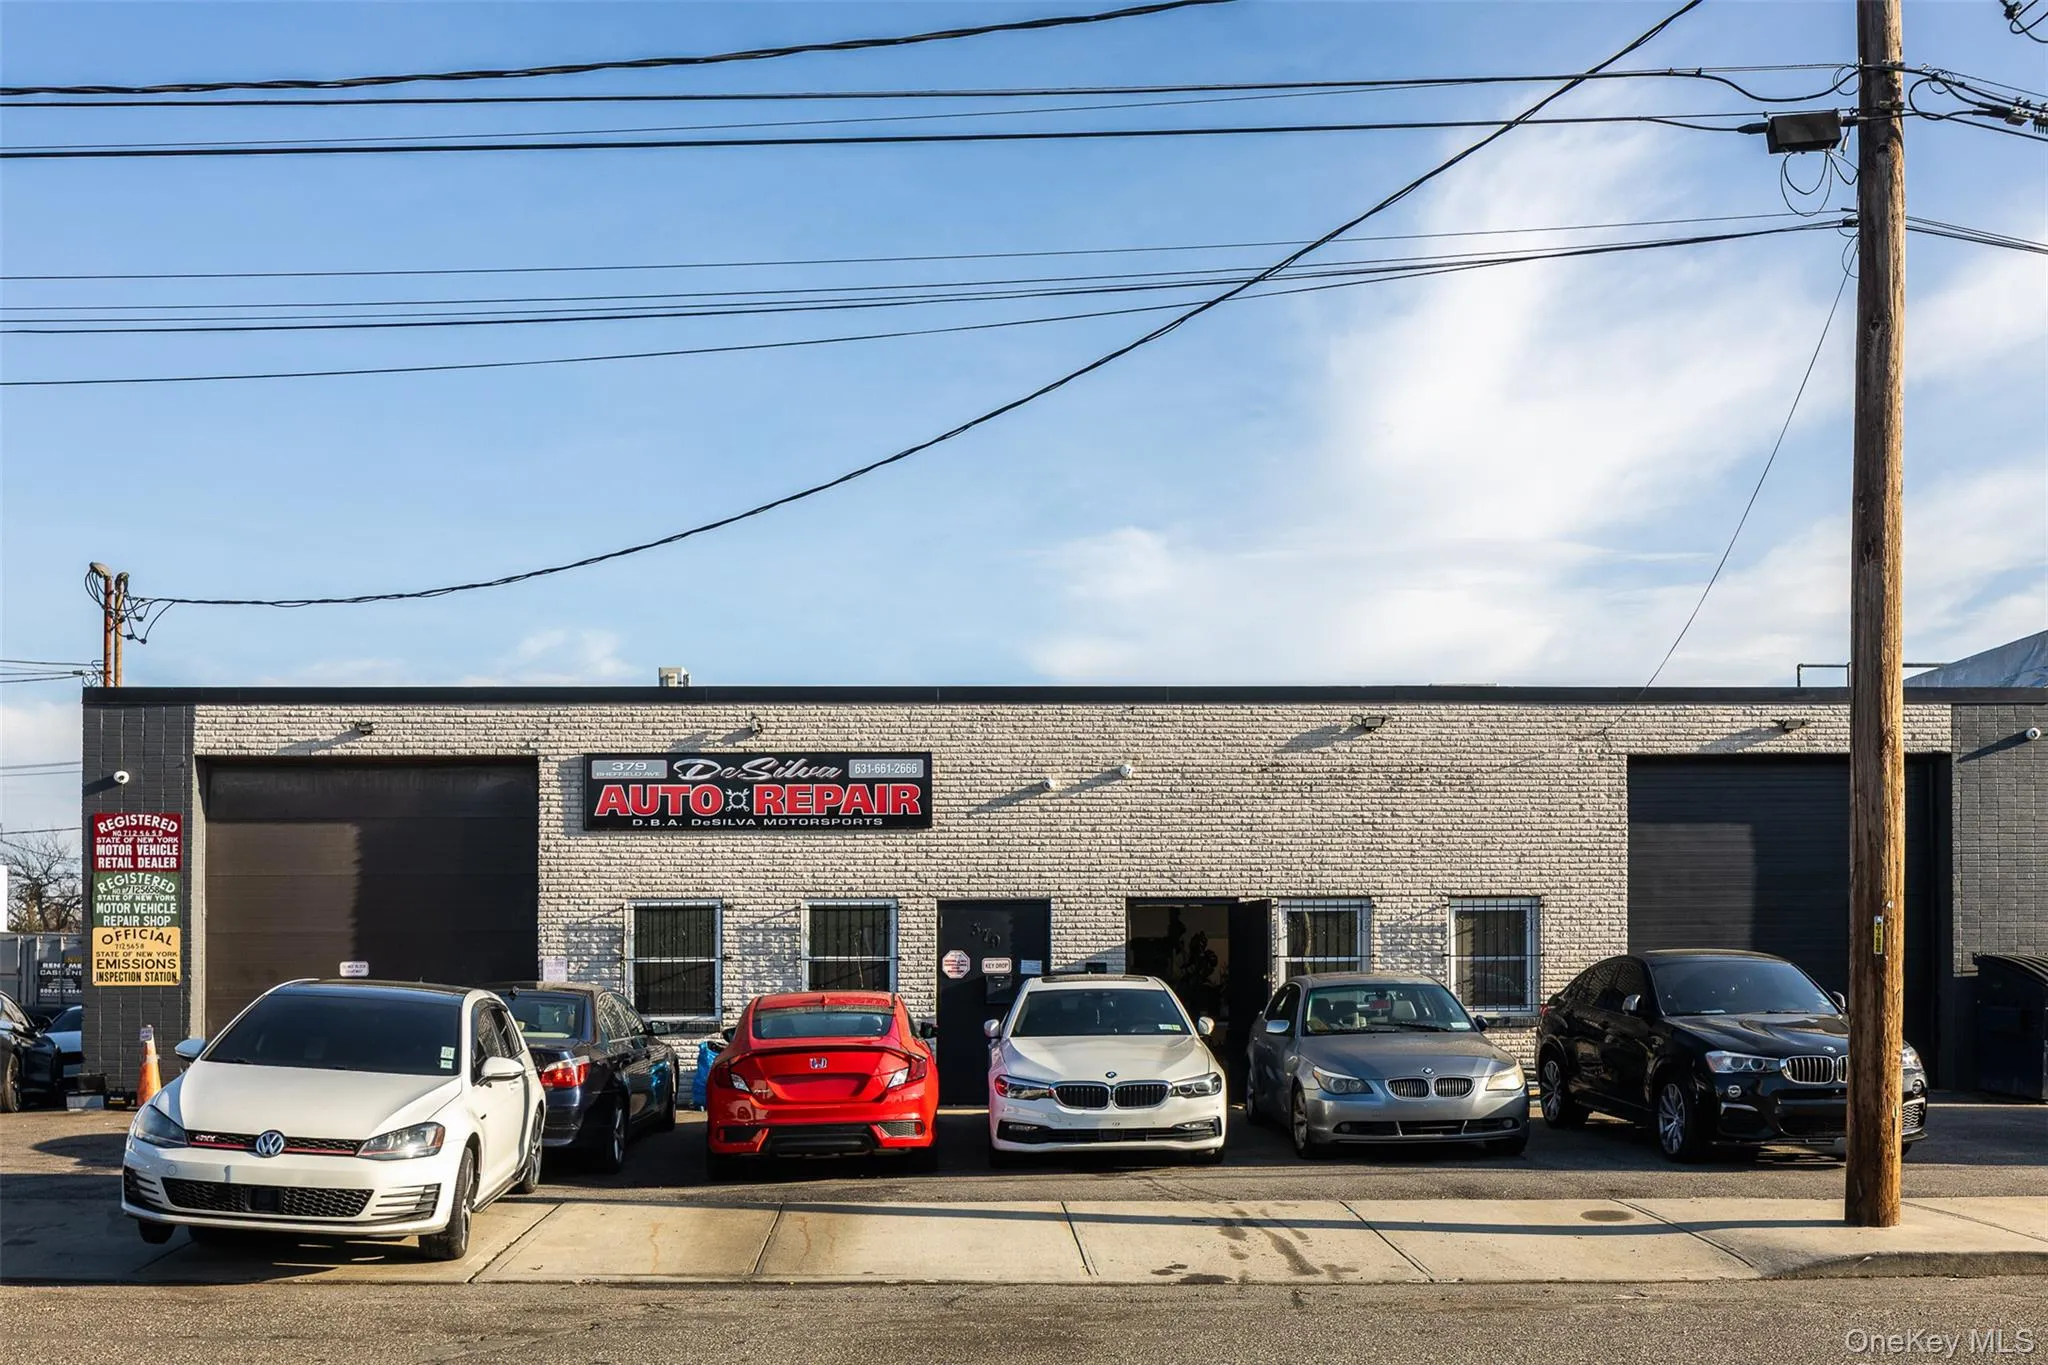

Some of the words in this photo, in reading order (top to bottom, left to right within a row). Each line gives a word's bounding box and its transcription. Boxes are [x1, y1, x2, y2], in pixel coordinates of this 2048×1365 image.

[612, 762, 647, 771] 379
[673, 758, 843, 781] DeSilva
[854, 763, 918, 774] 631-661-2666
[594, 783, 724, 817] AUTO
[753, 783, 922, 816] REPAIR
[97, 814, 178, 834] REGISTERED
[632, 818, 683, 826] D.B.A.
[691, 818, 756, 826] DeSILVA
[763, 818, 883, 826] MOTORSPORTS
[96, 844, 132, 856] MOTOR
[136, 844, 179, 856] VEHICLE
[98, 857, 134, 869] RETAIL
[137, 857, 177, 869] DEALER
[97, 872, 176, 894] REGISTERED
[96, 903, 131, 914] MOTOR
[133, 903, 177, 914] VEHICLE
[103, 915, 140, 927] REPAIR
[143, 915, 171, 926] SHOP
[101, 928, 172, 946] OFFICIAL
[96, 958, 177, 969] EMISSIONS
[96, 971, 142, 982] INSPECTION
[144, 971, 177, 982] STATION
